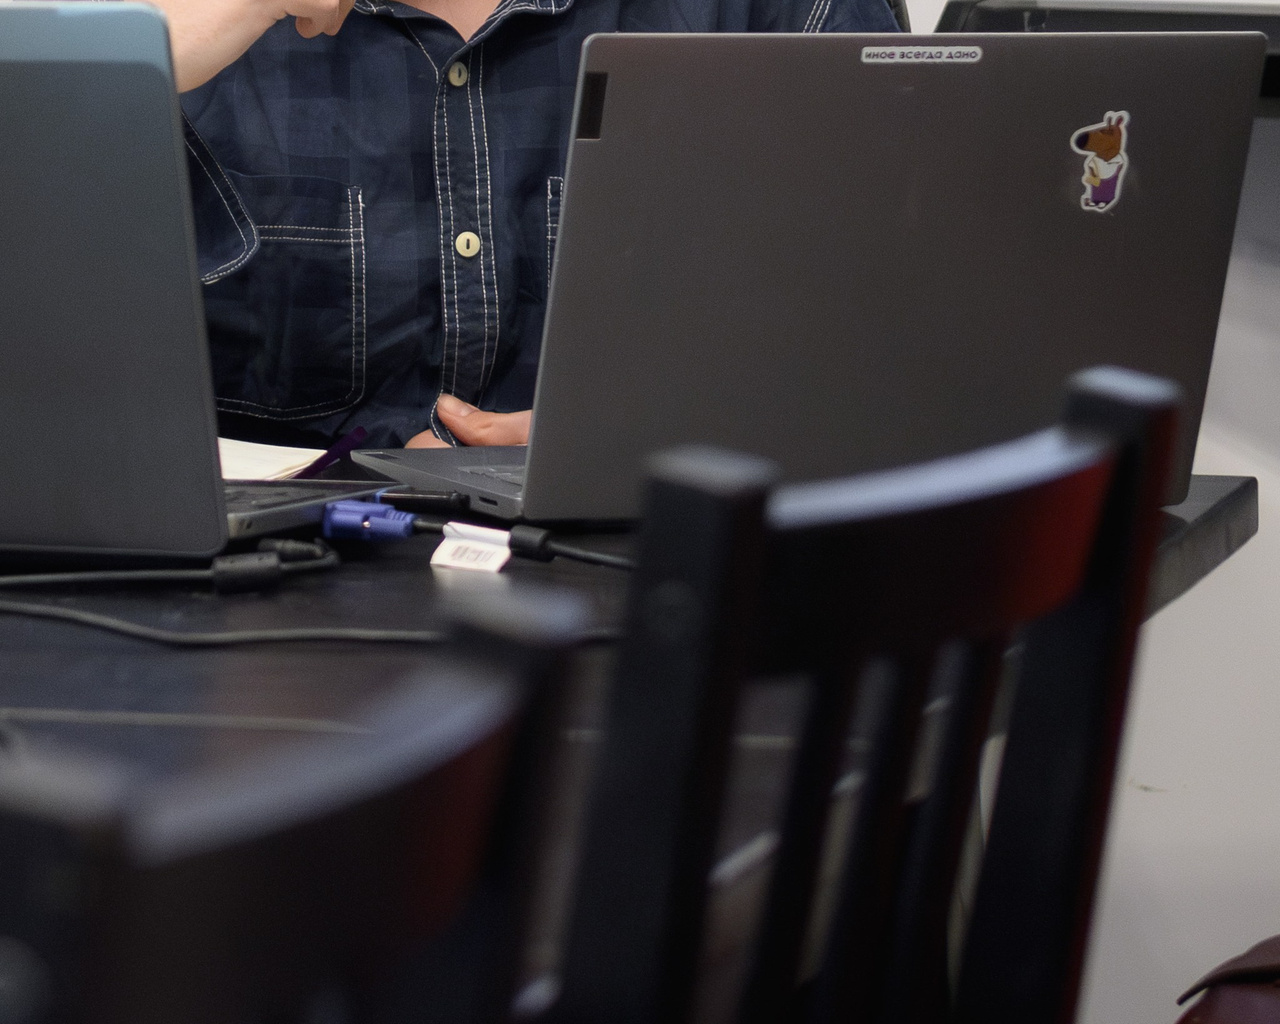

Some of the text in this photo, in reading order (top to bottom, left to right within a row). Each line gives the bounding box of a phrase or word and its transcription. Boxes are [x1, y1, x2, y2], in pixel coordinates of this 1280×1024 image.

[864, 50, 979, 60] иное всегда дано
